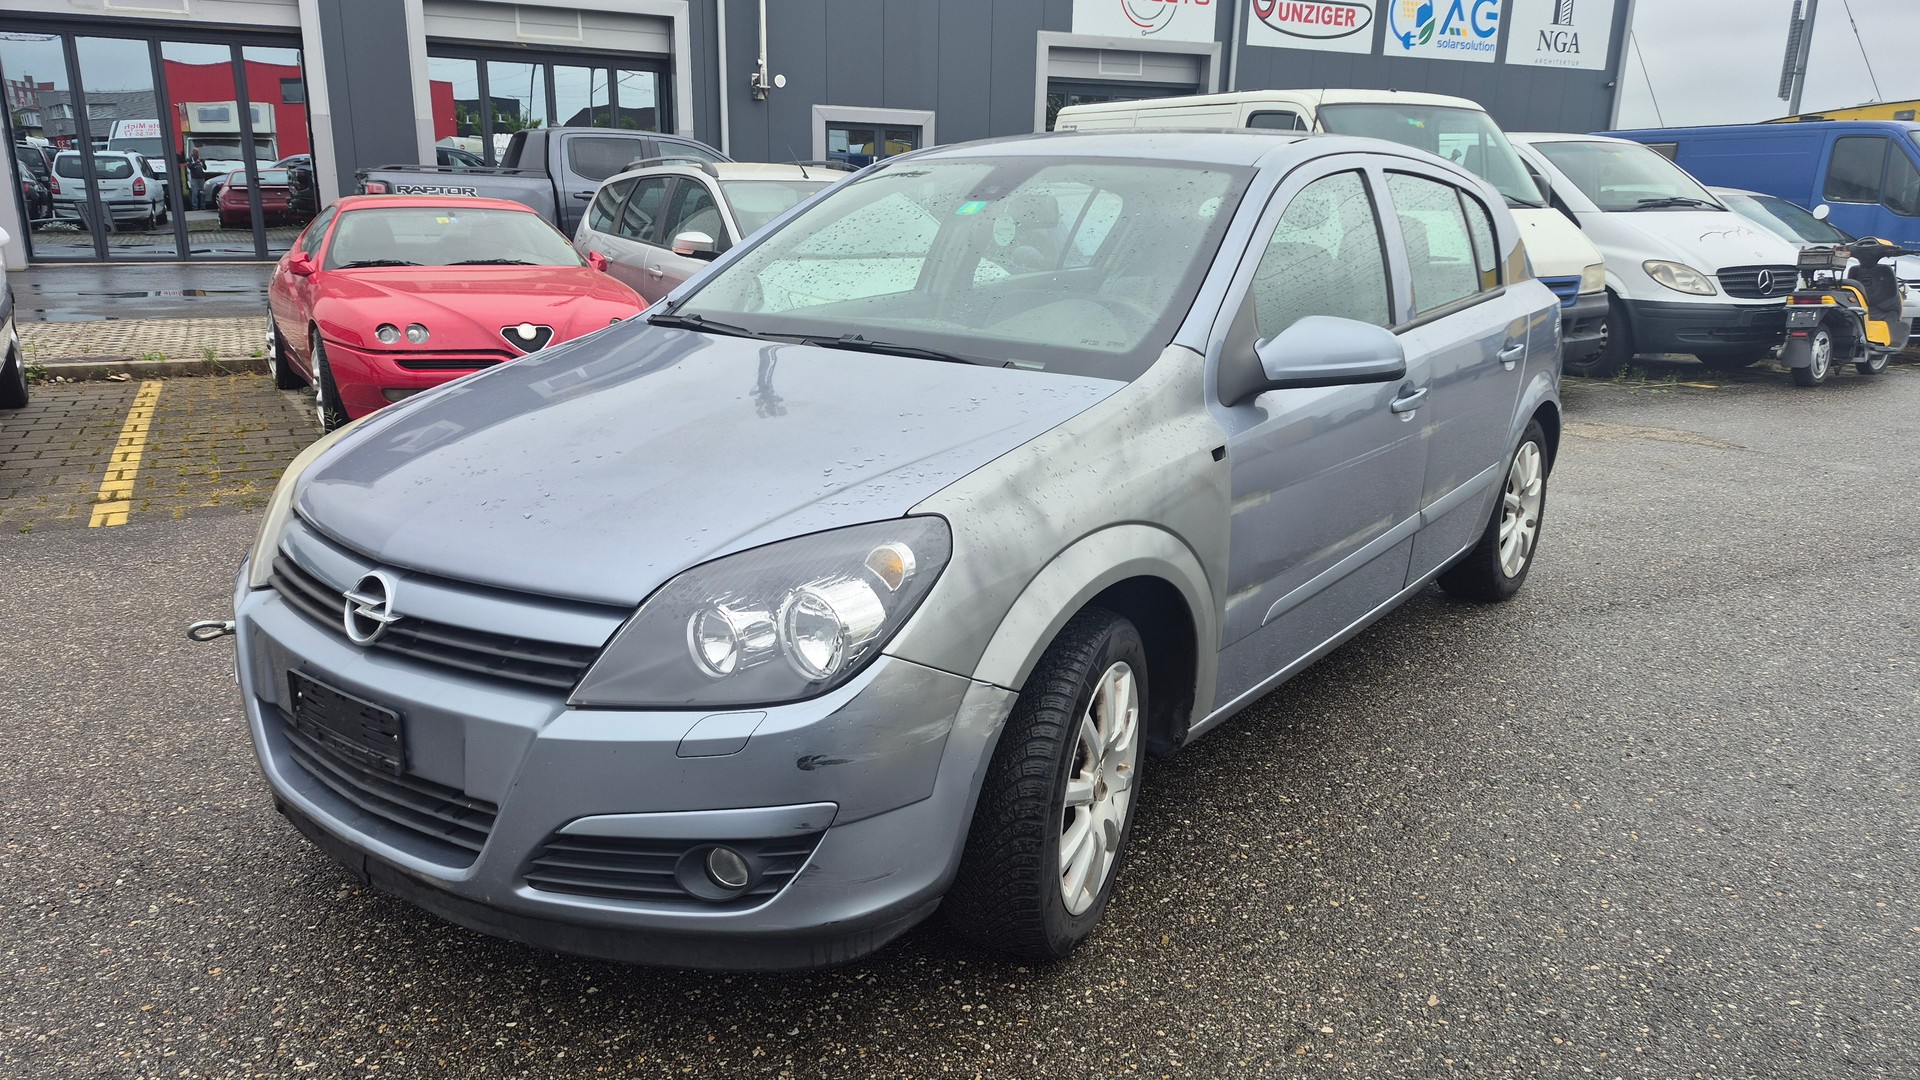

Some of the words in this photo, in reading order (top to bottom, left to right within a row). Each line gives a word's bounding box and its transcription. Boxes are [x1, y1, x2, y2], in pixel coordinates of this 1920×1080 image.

[1439, 0, 1499, 38] AG
[1437, 38, 1495, 51] solarsolution
[1536, 29, 1580, 54] NGA
[395, 184, 479, 198] RAPTOR
